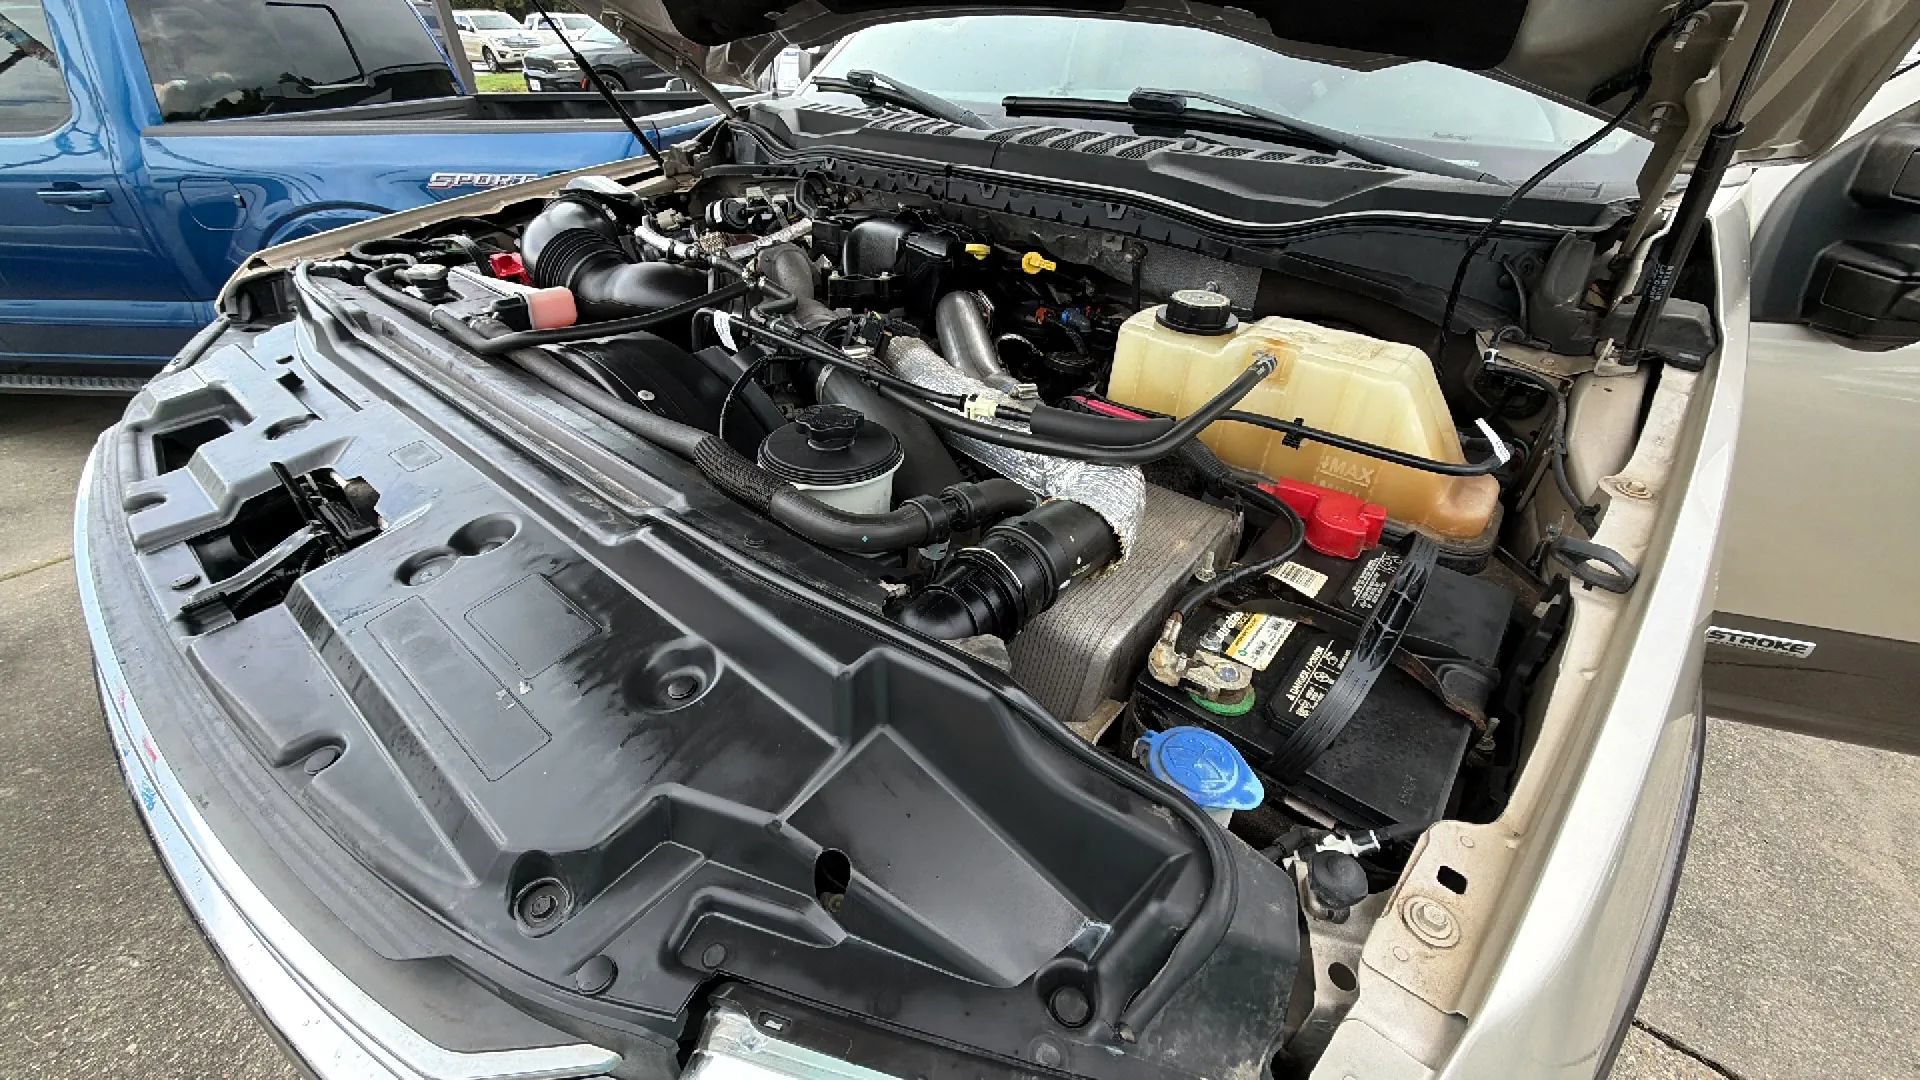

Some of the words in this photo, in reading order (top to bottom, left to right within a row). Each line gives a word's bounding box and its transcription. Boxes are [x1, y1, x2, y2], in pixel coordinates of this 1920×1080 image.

[427, 172, 538, 189] SPORT
[1330, 456, 1374, 484] MAX
[1708, 629, 1809, 655] STROKE
[1289, 670, 1310, 695] DANGER
